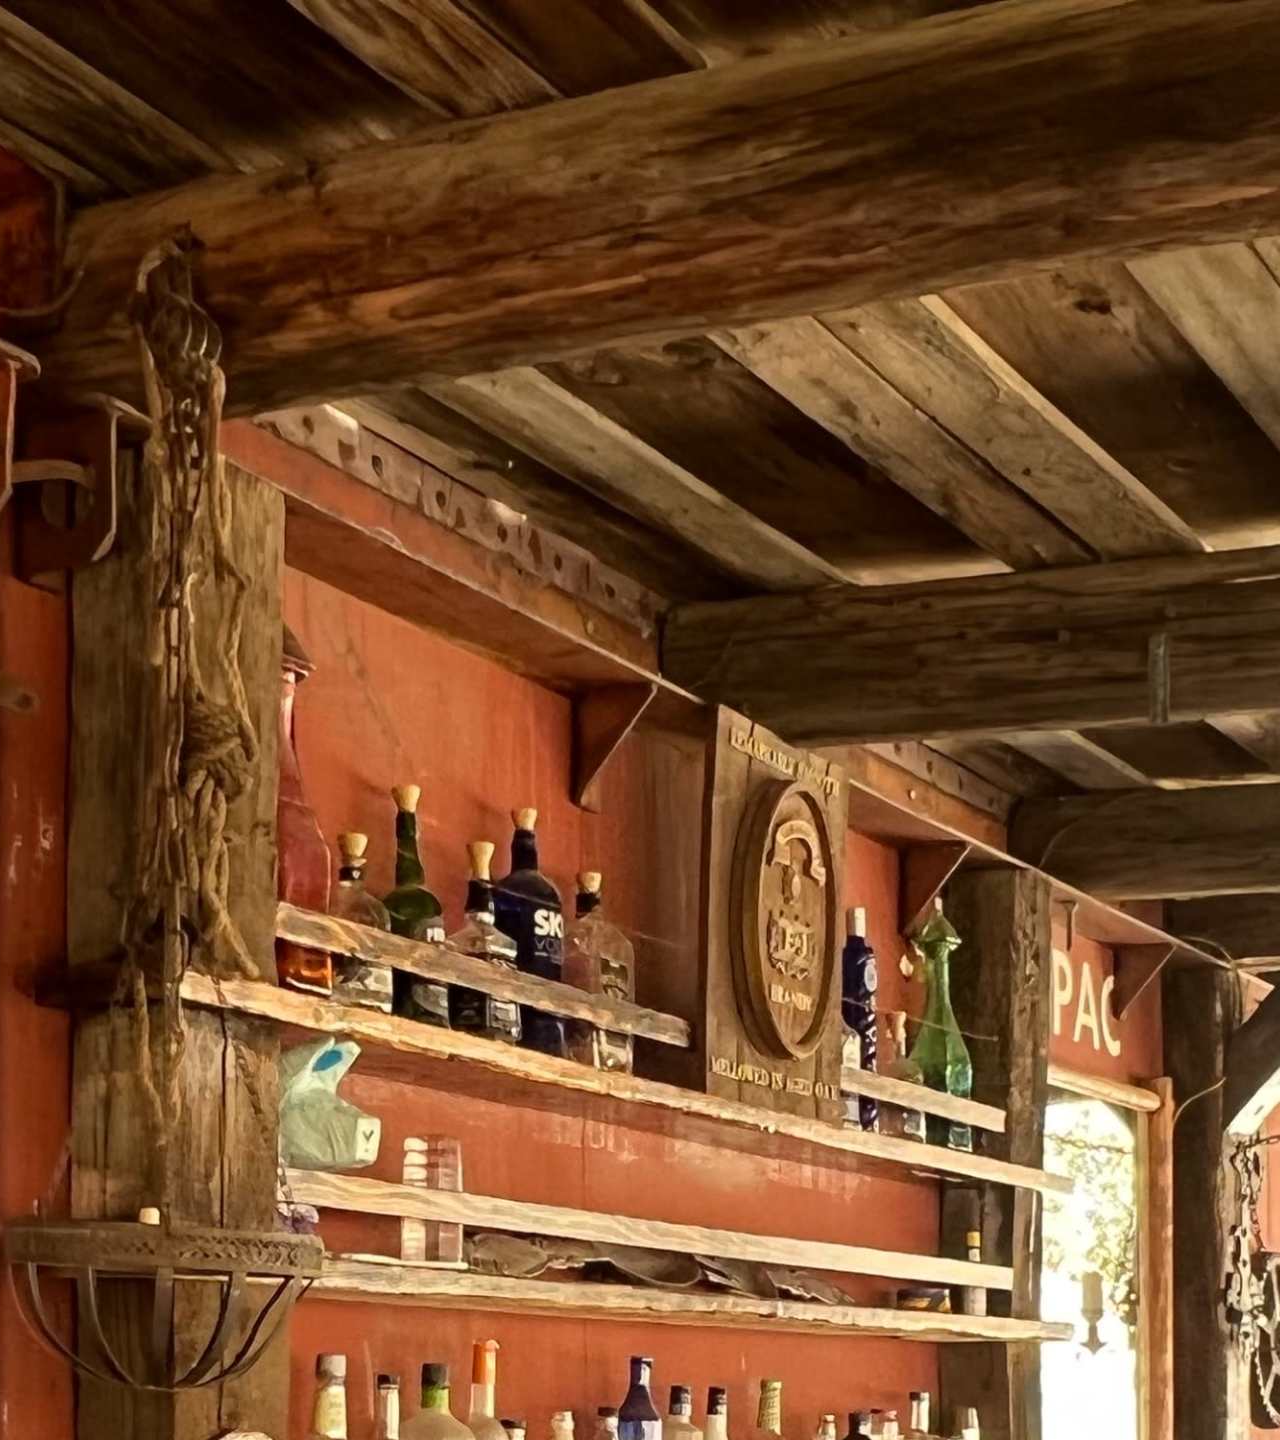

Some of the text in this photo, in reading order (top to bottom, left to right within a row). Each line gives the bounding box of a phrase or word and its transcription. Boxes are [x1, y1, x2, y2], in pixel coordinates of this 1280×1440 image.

[534, 909, 564, 938] SK
[771, 983, 813, 1011] BRANDY
[711, 1055, 769, 1087] MELLOWED
